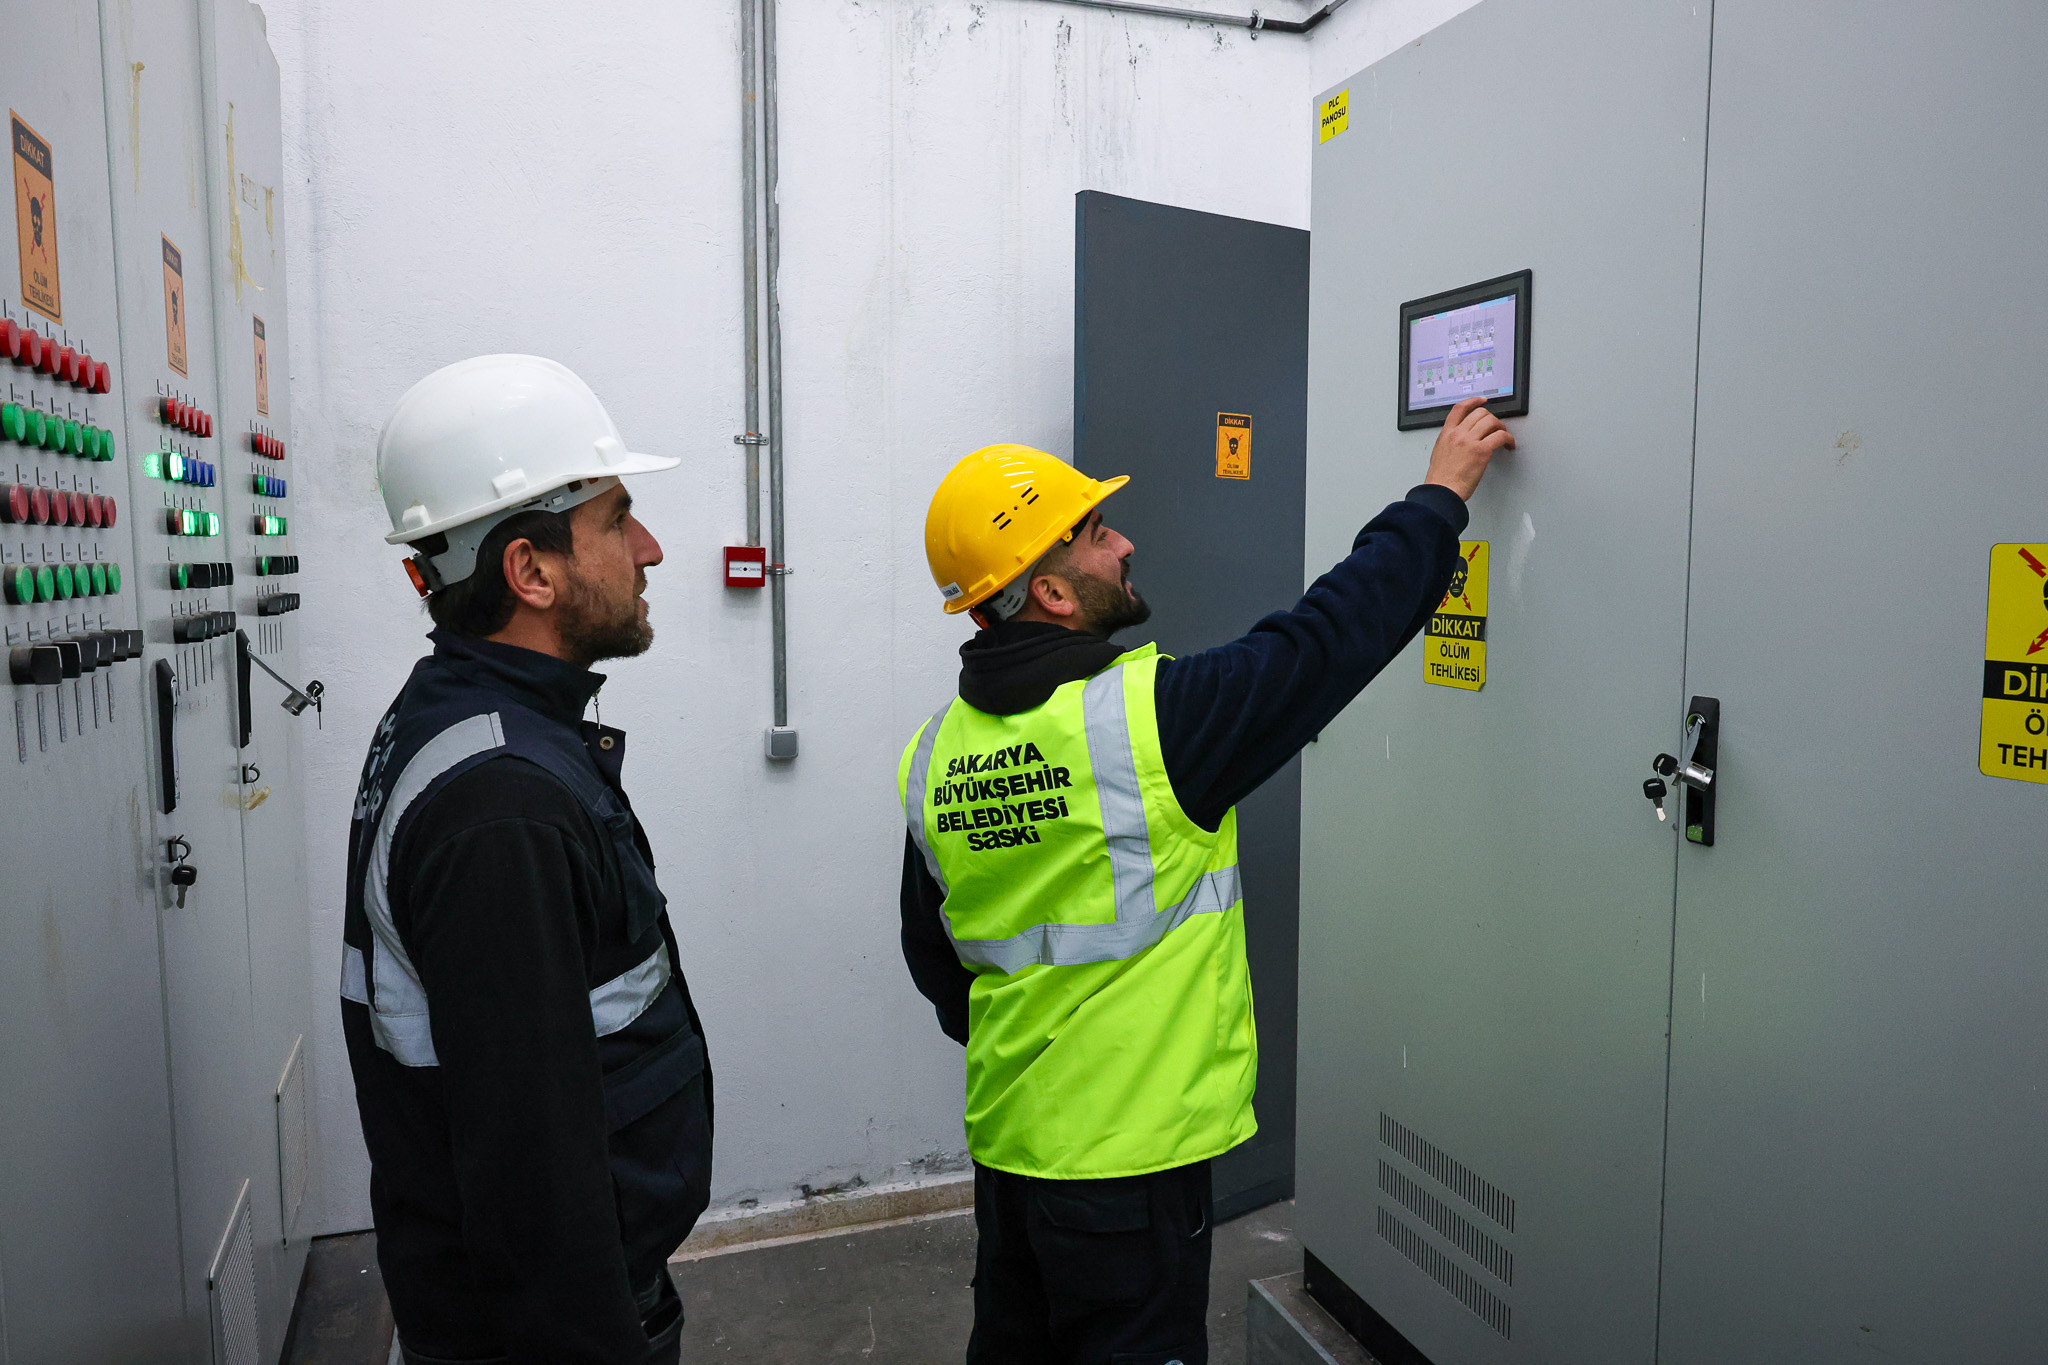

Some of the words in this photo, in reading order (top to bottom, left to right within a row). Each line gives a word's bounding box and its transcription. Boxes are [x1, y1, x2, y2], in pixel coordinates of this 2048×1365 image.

[1328, 95, 1339, 110] PLC
[1321, 105, 1346, 127] PANOSU
[1332, 126, 1335, 135] 1
[20, 134, 45, 167] DİKKAT
[1224, 417, 1244, 425] DİKKAT
[1431, 615, 1480, 637] DİKKAT
[1440, 641, 1470, 660] ÖLÜM
[1430, 663, 1480, 683] TEHLİKESİ
[946, 742, 1045, 778] SAKARYA
[1997, 743, 2048, 770] TEH
[933, 764, 1073, 807] BÜYÜKŞEHİR
[937, 795, 1069, 833] BELEDİYESİ
